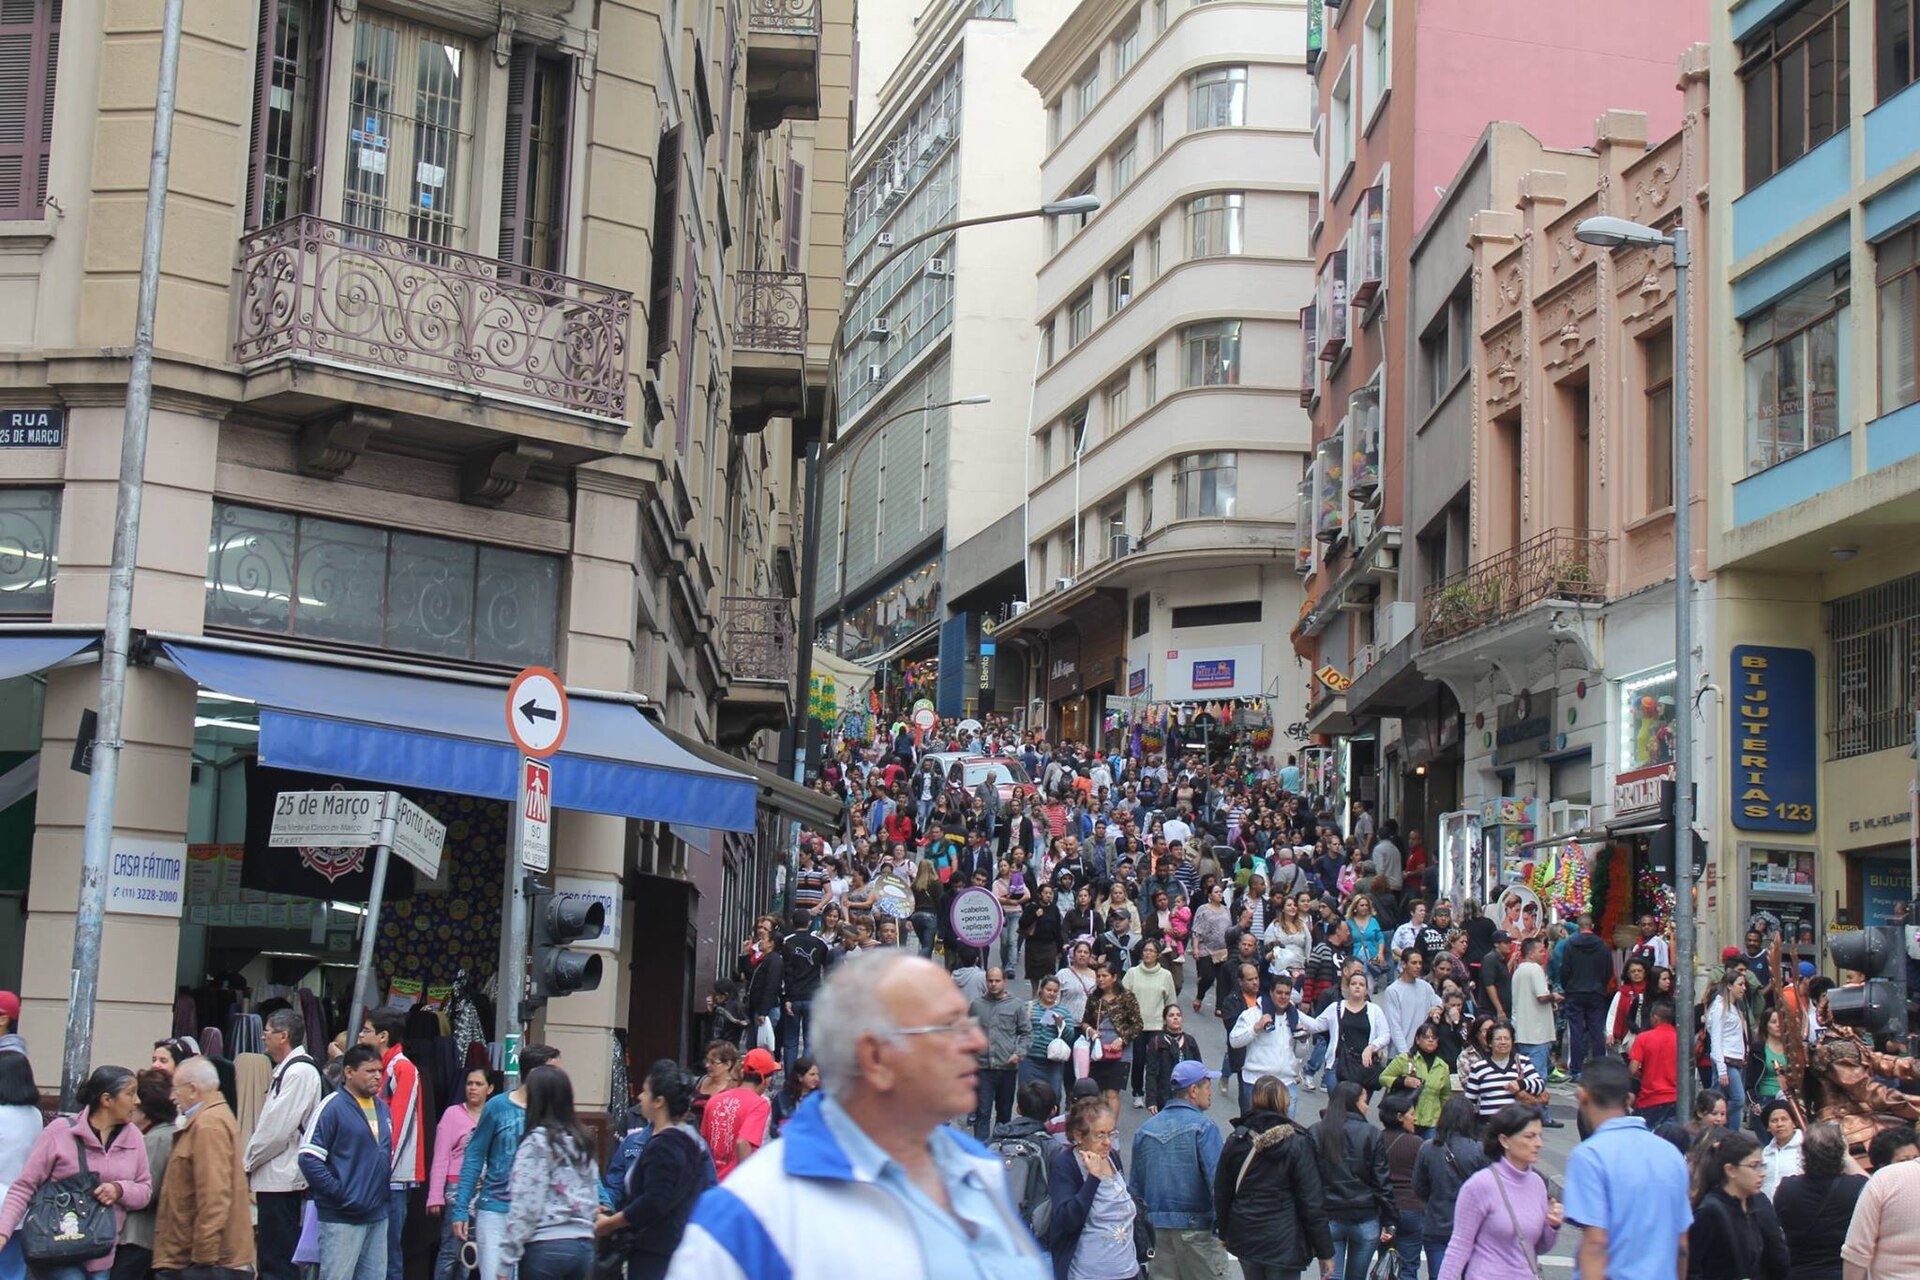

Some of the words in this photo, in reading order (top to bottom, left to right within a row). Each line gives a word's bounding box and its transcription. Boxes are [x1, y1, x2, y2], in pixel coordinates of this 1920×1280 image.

[12, 413, 48, 426] RUA
[0, 429, 10, 443] 25
[13, 429, 25, 443] DE
[27, 429, 60, 446] MARÇO
[1320, 666, 1351, 691] 103
[1741, 655, 1771, 818] BIJUTERIAS
[277, 796, 294, 816] 25
[298, 794, 318, 815] de
[322, 795, 370, 821] Março
[1775, 802, 1813, 822] 123
[274, 824, 287, 832] Rua
[310, 824, 328, 832] Cinco
[341, 824, 362, 833] Março
[400, 802, 423, 834] Porto
[423, 819, 445, 849] Geral
[113, 853, 140, 877] CASA
[142, 851, 181, 881] FÁTIMA
[121, 887, 135, 898] (11)
[136, 888, 178, 903] 3228-2000
[964, 906, 989, 914] cabelos
[965, 915, 991, 923] perucas
[966, 923, 993, 931] apliques
